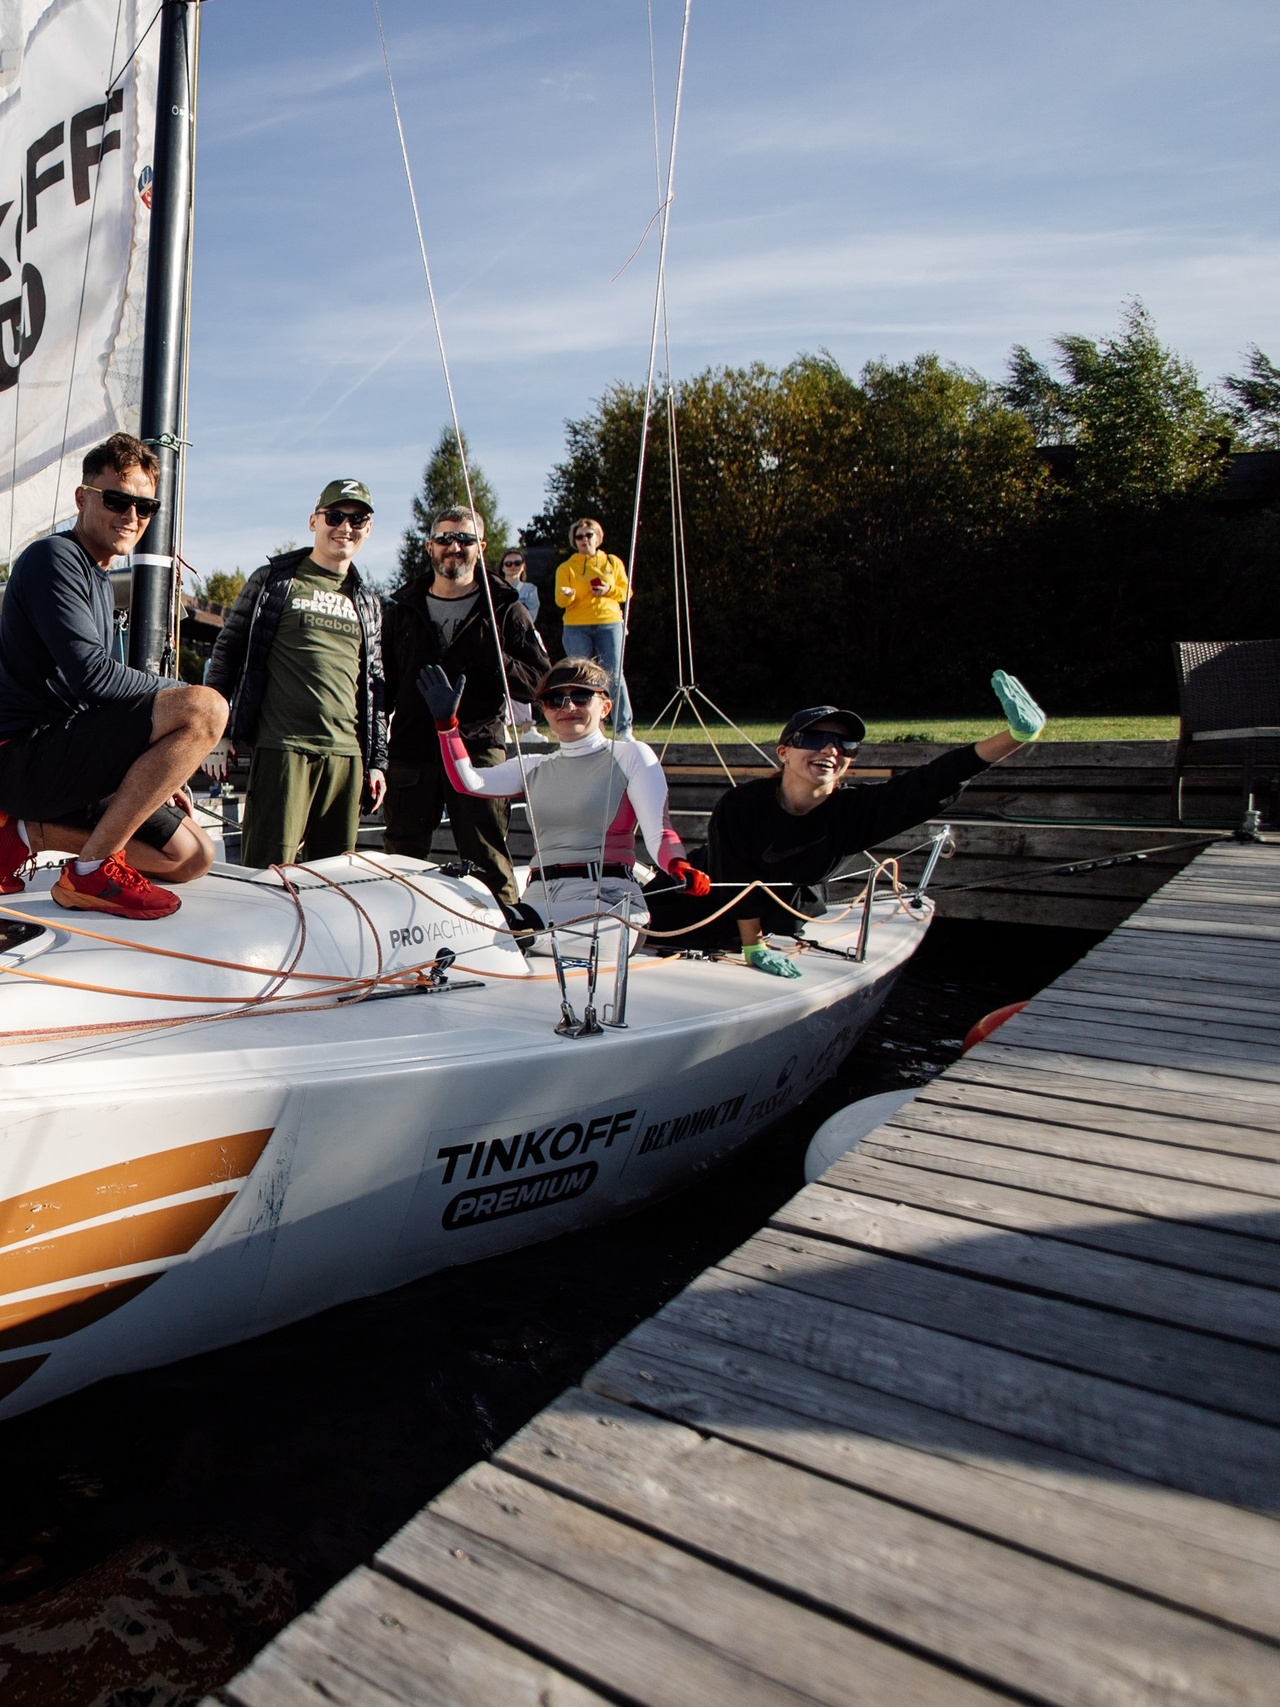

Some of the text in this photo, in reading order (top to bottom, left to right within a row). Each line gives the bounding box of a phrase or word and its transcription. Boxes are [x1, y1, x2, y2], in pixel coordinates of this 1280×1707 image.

[291, 597, 359, 621] SPECTATO
[312, 589, 355, 610] NOT A
[303, 613, 359, 636] Reebok
[389, 912, 495, 949] PROYACHTING
[437, 1109, 637, 1185] TINKOFF
[451, 1168, 590, 1218] PREMIUM
